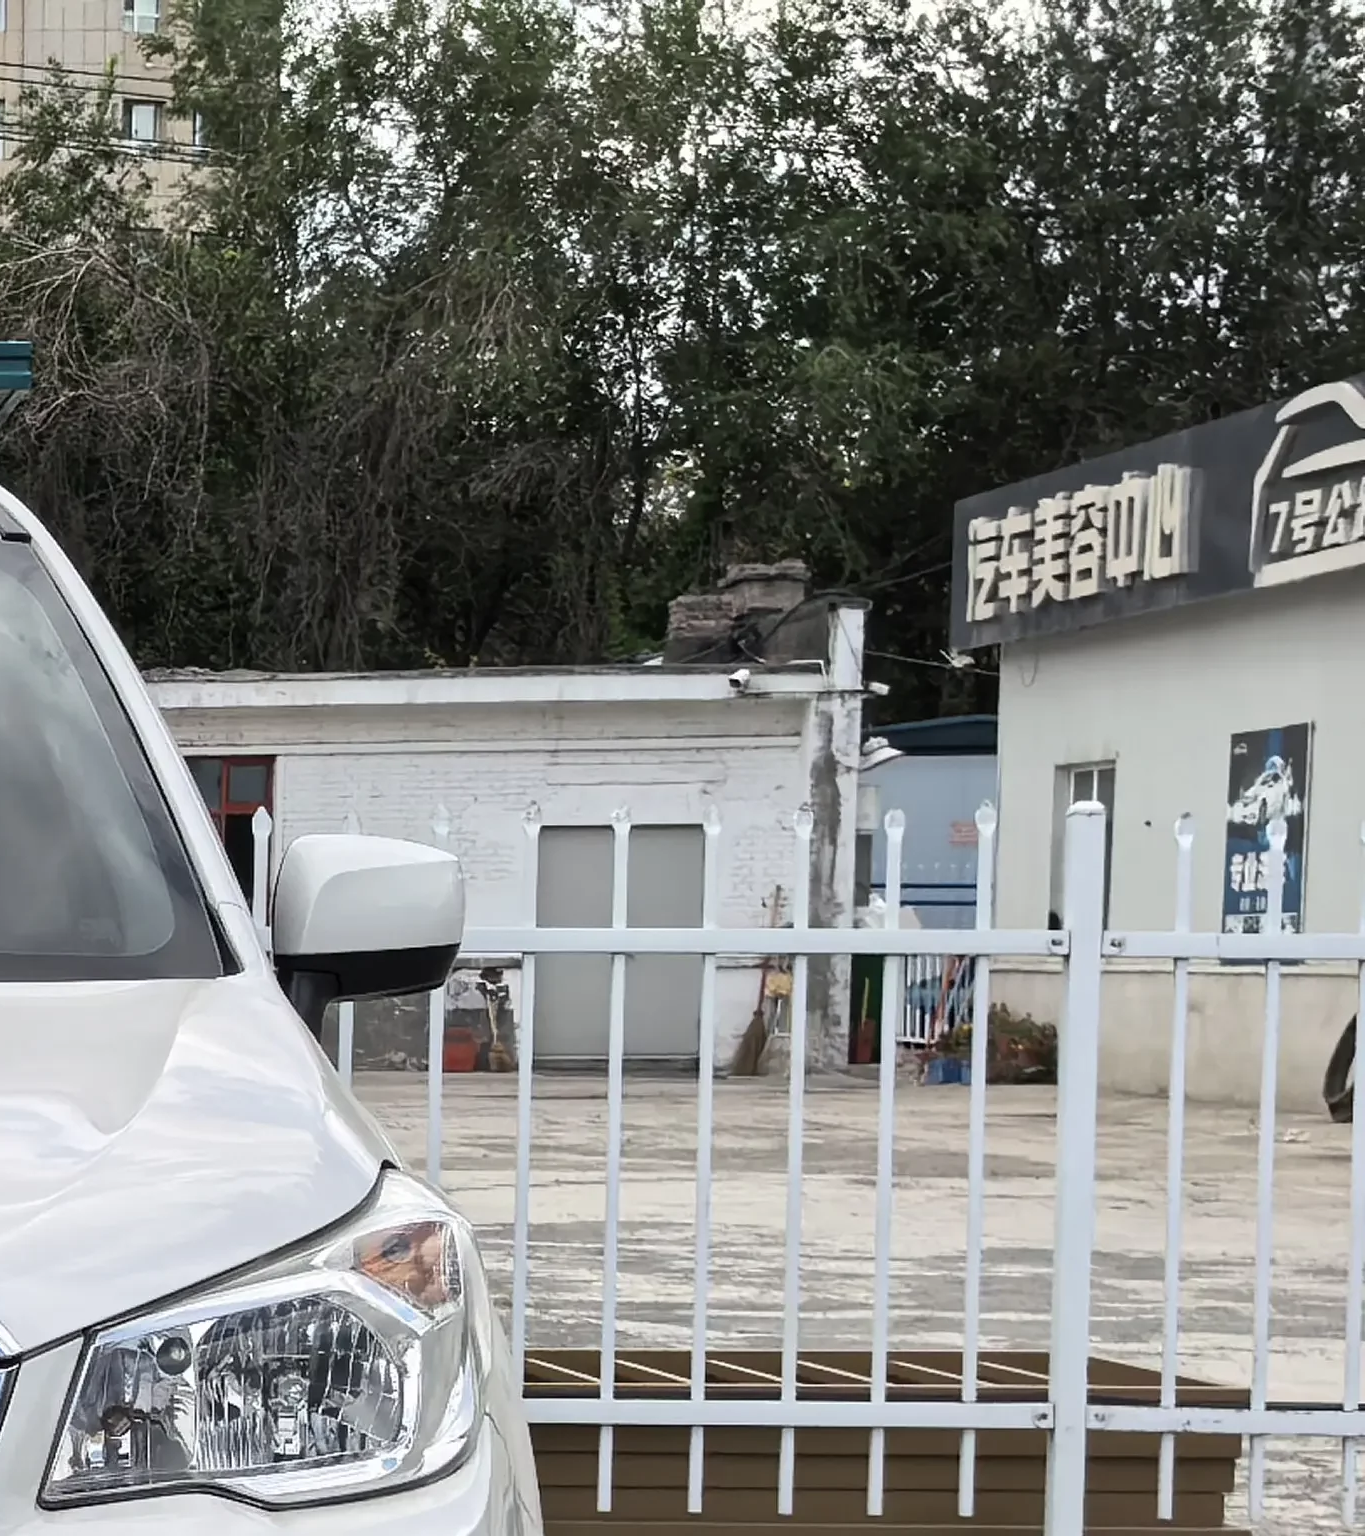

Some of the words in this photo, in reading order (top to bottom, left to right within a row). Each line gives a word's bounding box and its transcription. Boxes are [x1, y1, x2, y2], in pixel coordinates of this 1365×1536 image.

[966, 464, 1192, 622] 汽车美容中心
